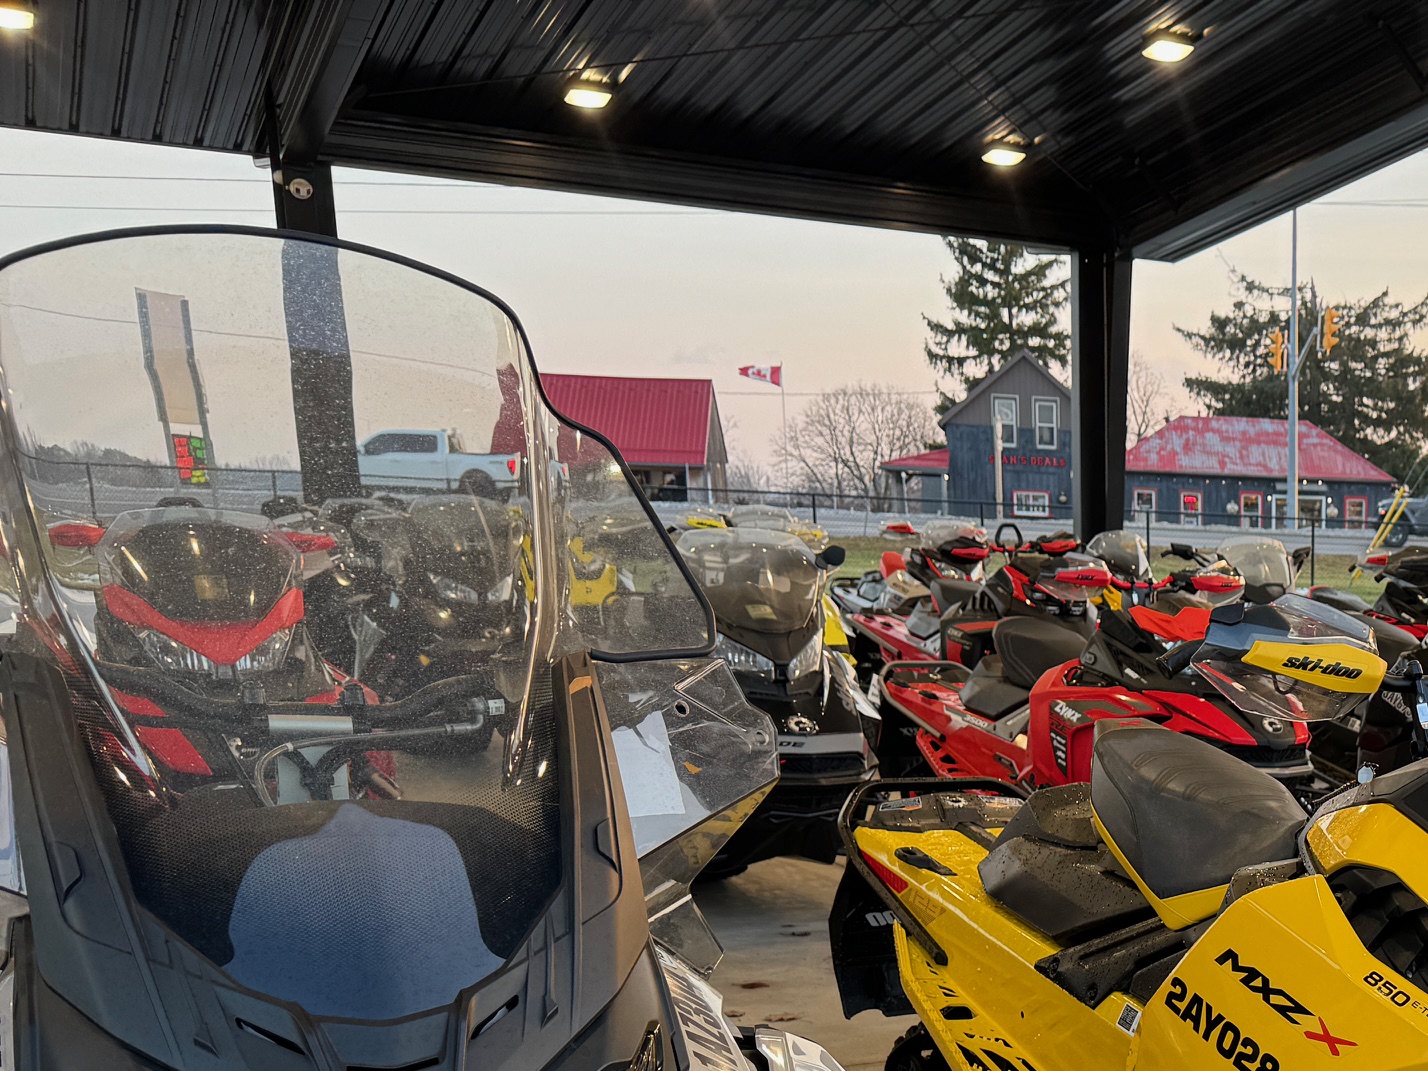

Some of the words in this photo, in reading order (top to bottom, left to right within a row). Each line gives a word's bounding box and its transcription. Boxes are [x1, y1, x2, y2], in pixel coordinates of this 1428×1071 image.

[988, 454, 1027, 466] SAN'S
[1031, 456, 1066, 468] DEALS
[1282, 656, 1363, 679] ski-doo
[1054, 702, 1082, 722] LYNX
[1363, 971, 1411, 1007] 850
[1215, 948, 1317, 1025] MXZ
[1303, 1016, 1358, 1057] X
